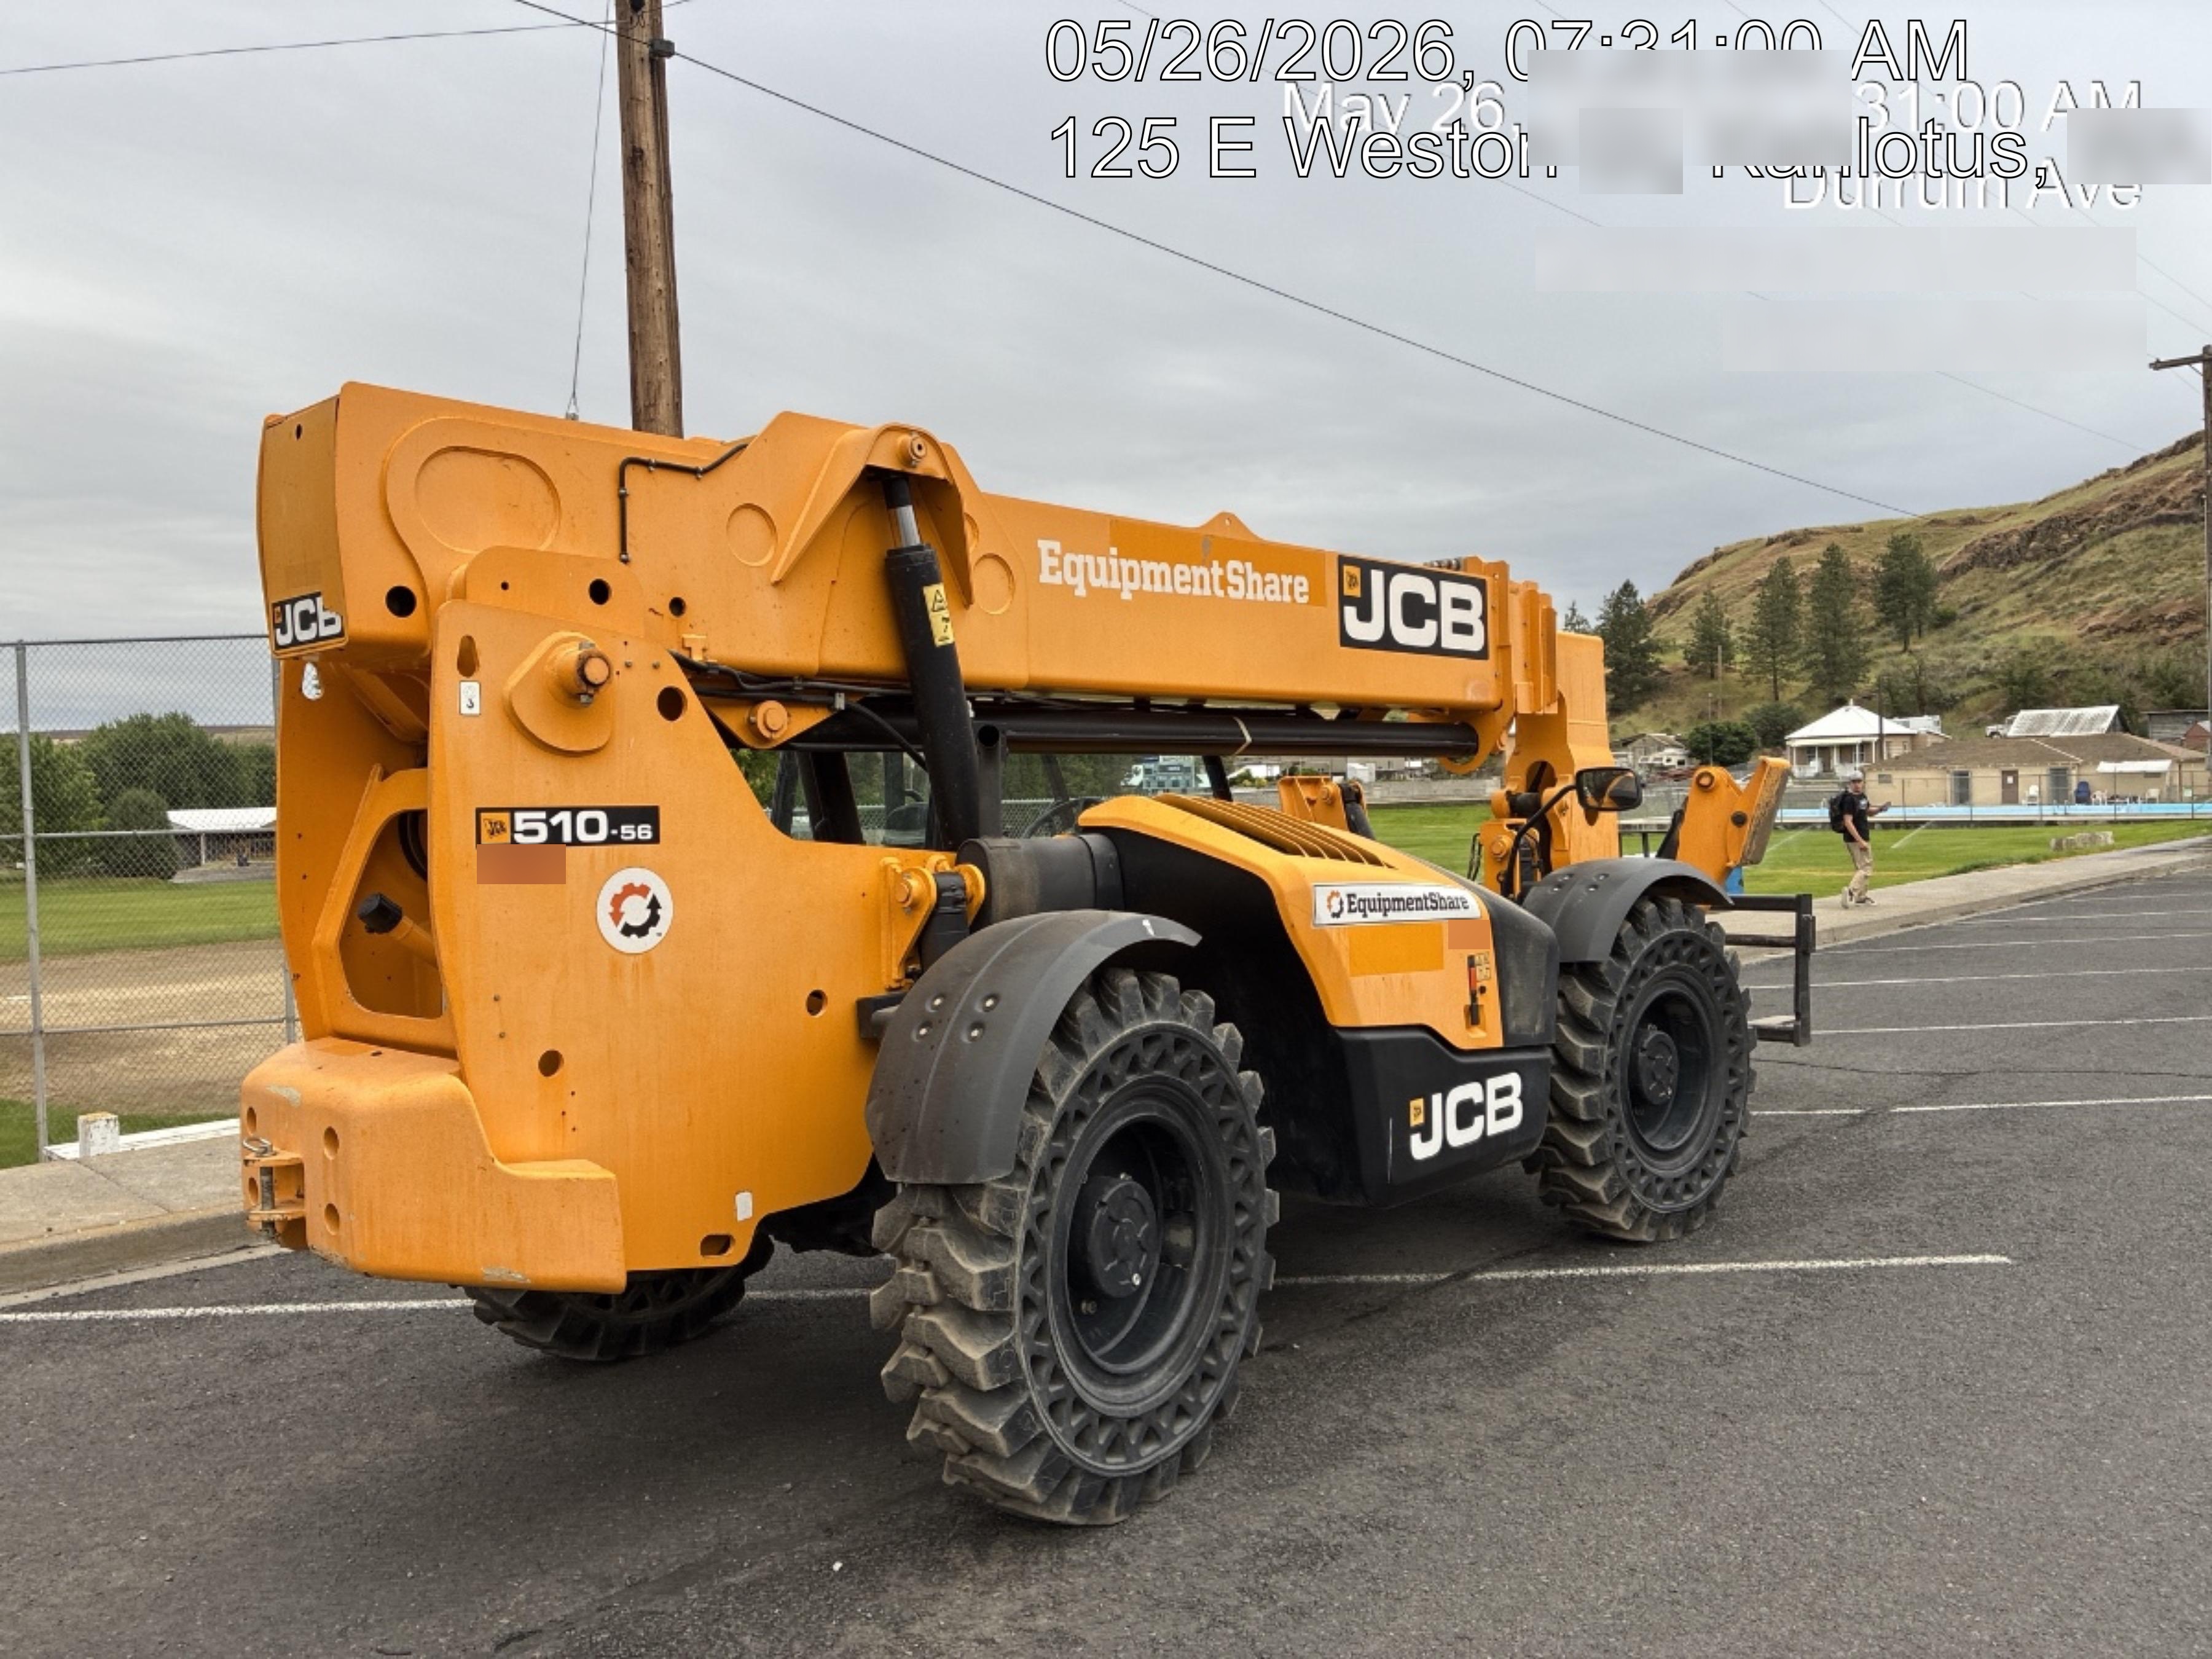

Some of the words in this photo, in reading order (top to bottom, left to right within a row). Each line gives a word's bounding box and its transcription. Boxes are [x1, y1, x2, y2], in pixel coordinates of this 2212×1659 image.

[1037, 539, 1310, 604] EquipmentShare
[1343, 569, 1484, 651] JCB
[513, 810, 653, 844] 510-56
[1346, 892, 1470, 917] EquipmentShare
[1410, 1072, 1523, 1161] JCB
